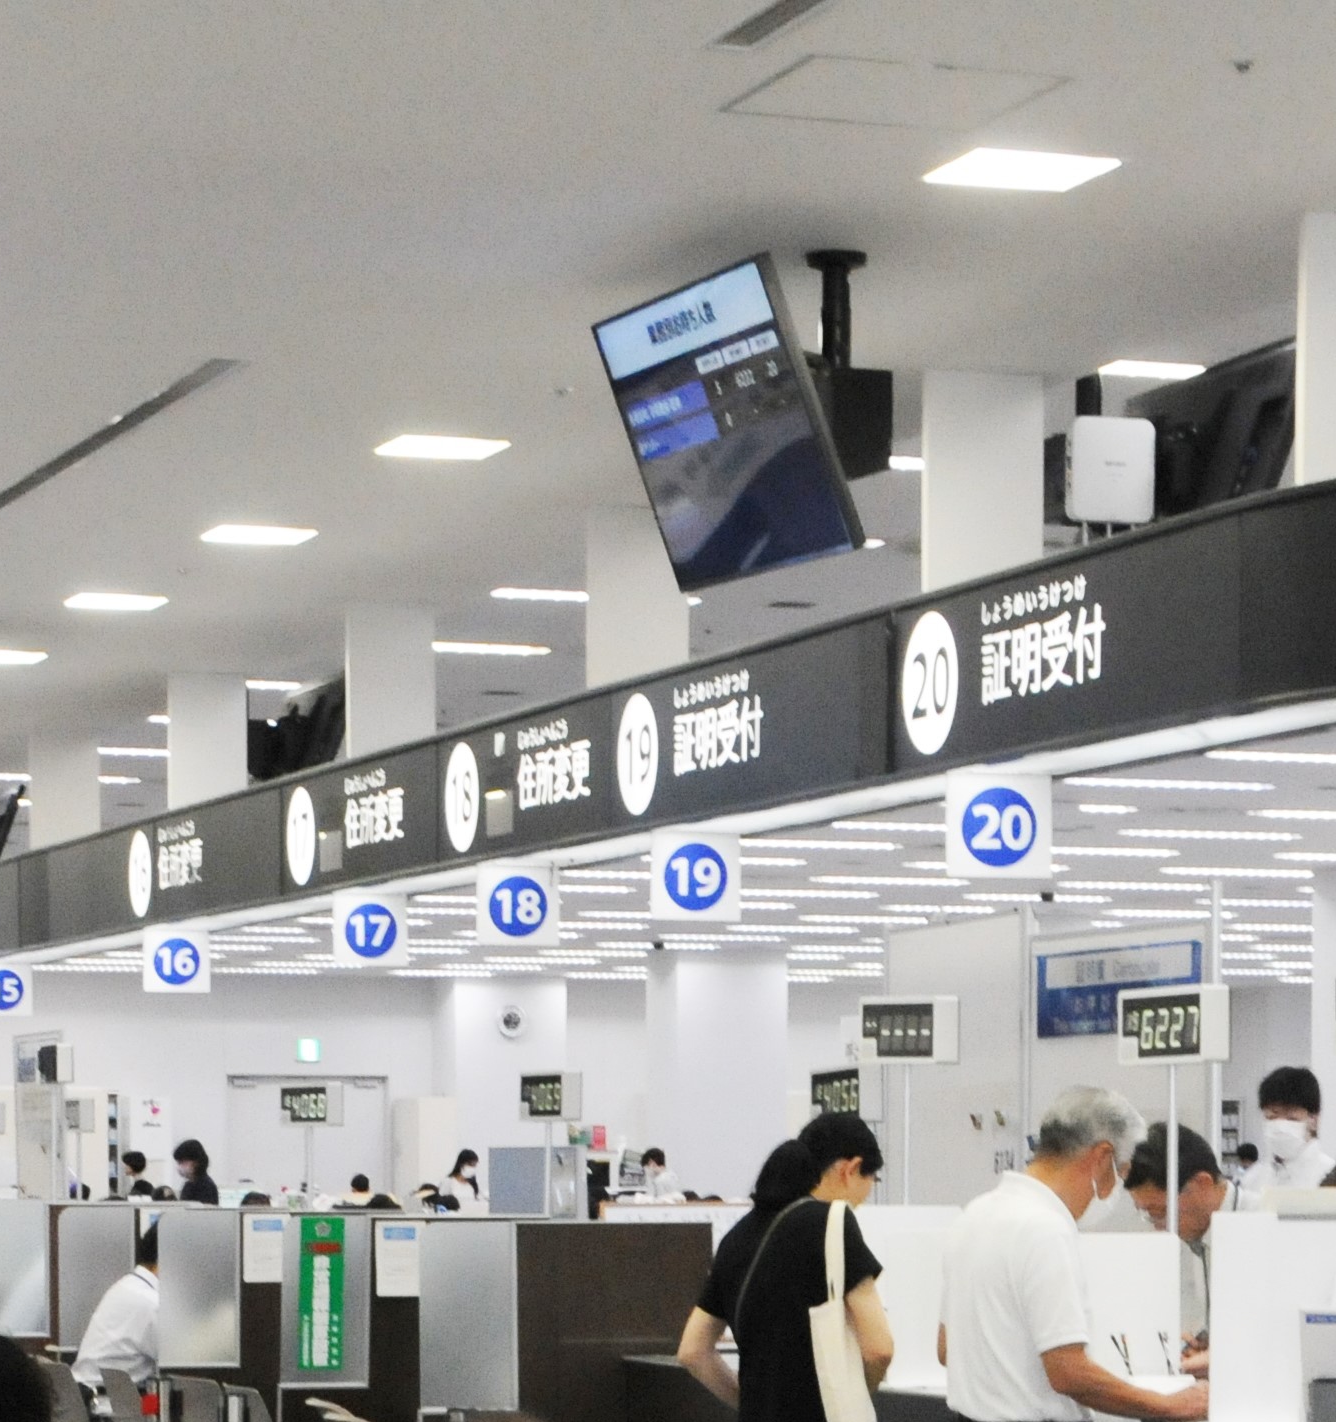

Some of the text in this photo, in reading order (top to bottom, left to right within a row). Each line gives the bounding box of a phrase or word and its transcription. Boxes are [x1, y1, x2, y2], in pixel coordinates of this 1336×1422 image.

[981, 574, 1087, 626] しょうめいうけつけ
[981, 603, 1107, 706] 証明受付
[912, 646, 951, 720] 20
[626, 724, 652, 785] 19
[674, 694, 764, 777] 証明受付
[517, 739, 592, 810] 住所変更
[970, 803, 1033, 852] 20
[671, 857, 722, 897] 19
[348, 913, 391, 948] 17
[495, 888, 542, 925] 18
[157, 947, 196, 976] 16
[1140, 1005, 1200, 1050] 6227
